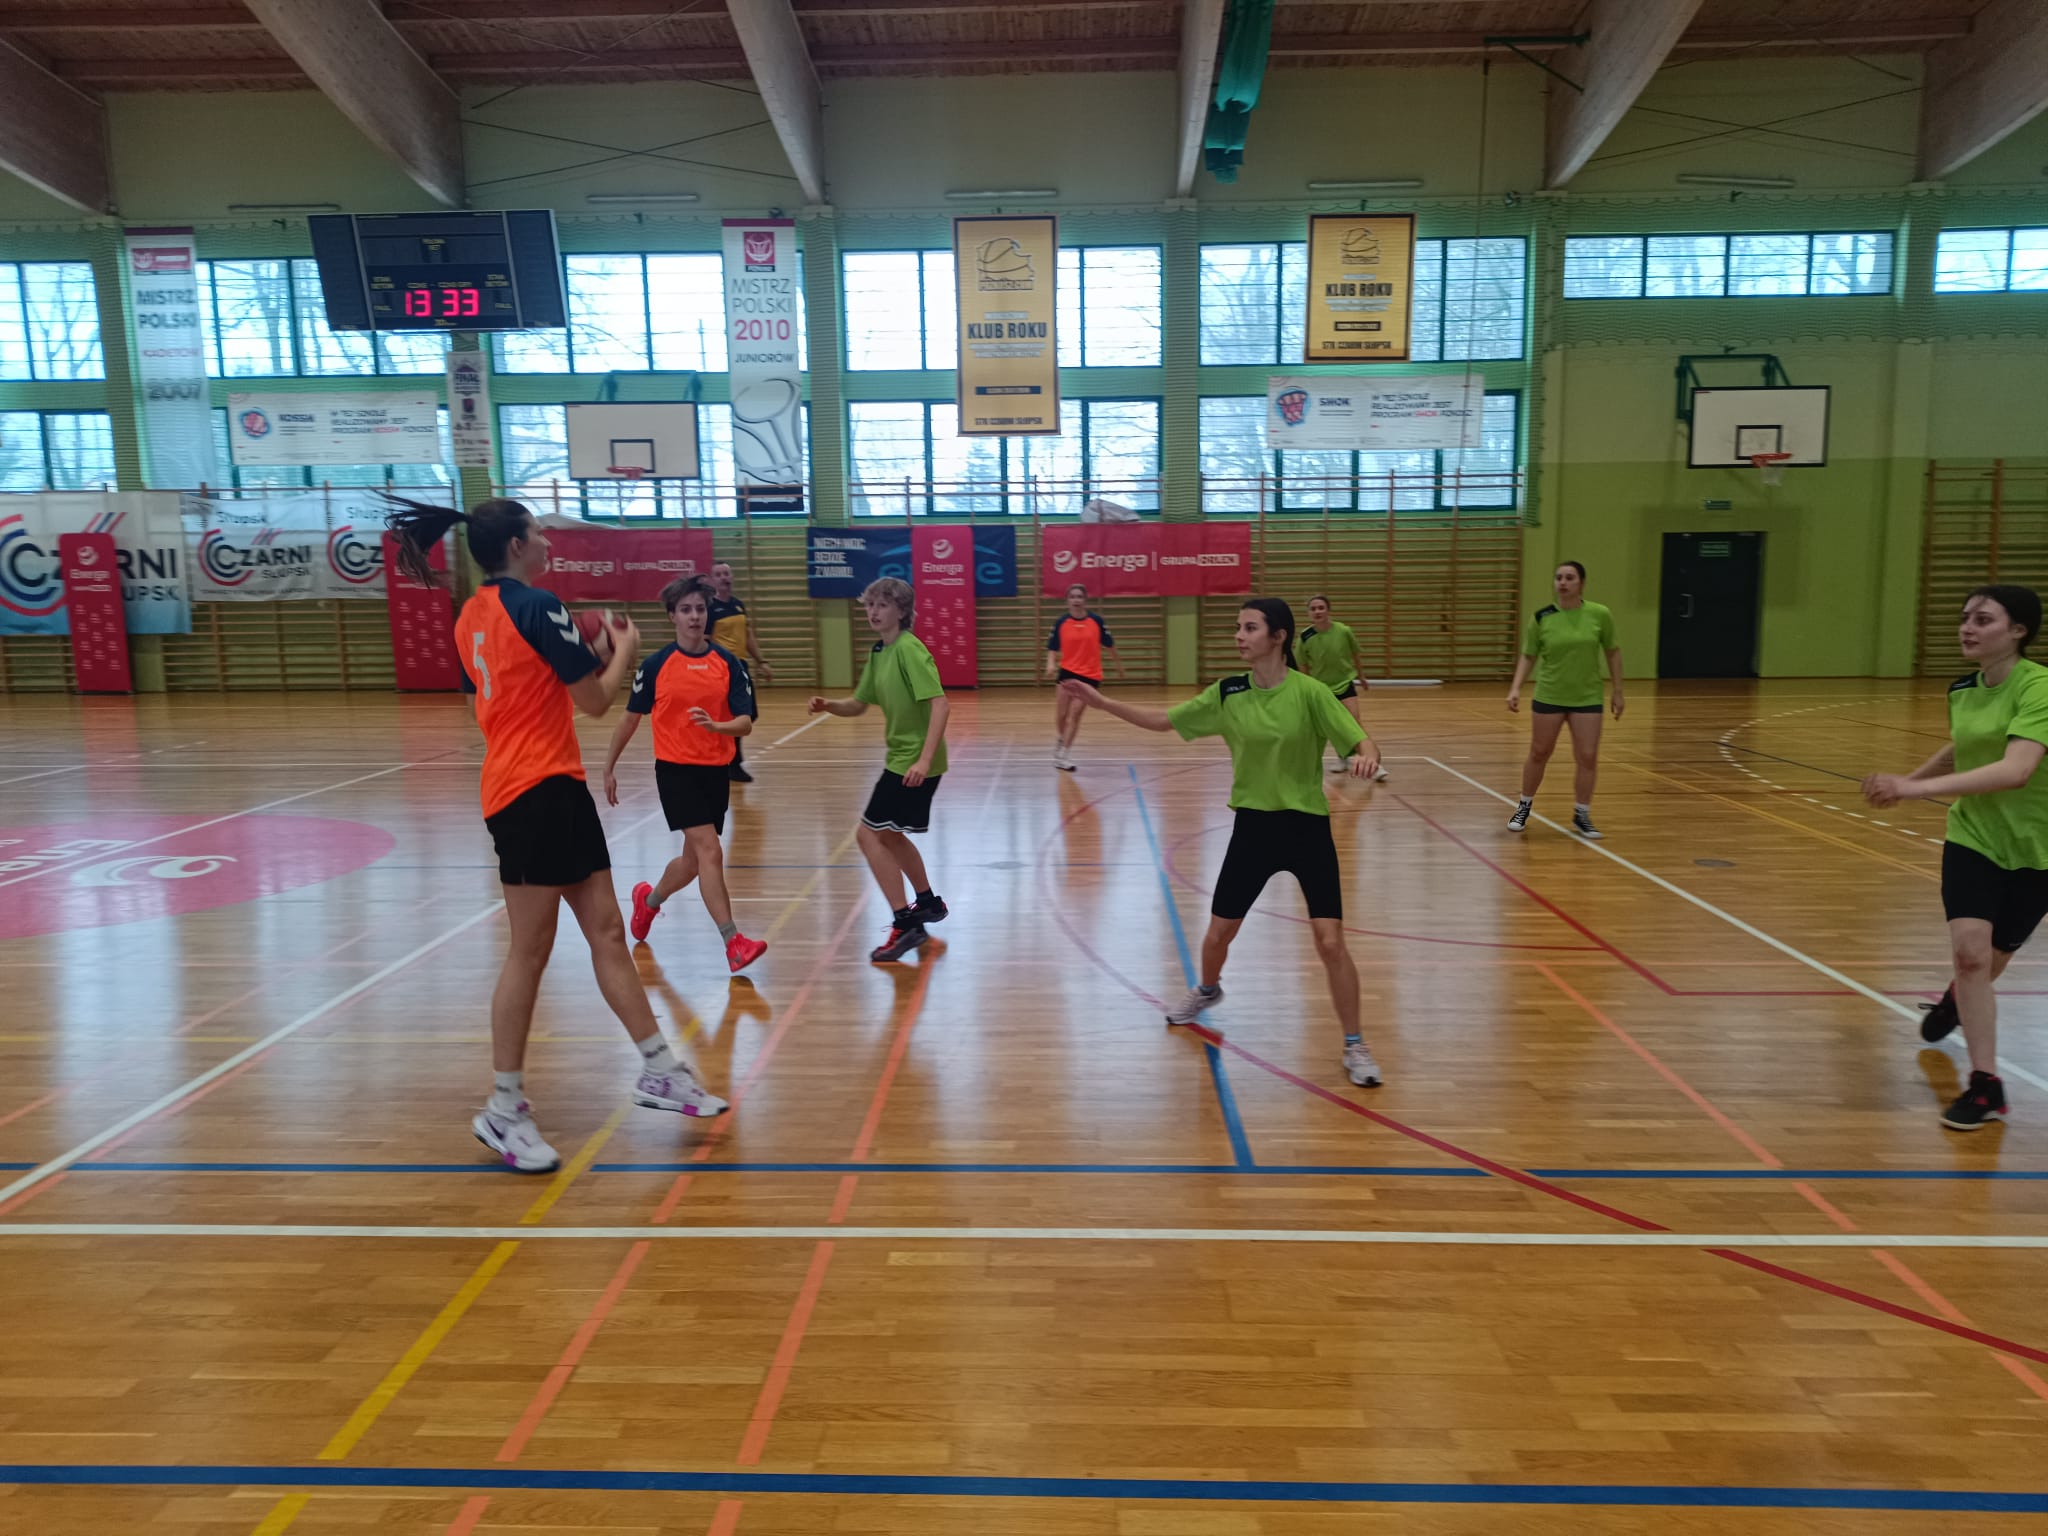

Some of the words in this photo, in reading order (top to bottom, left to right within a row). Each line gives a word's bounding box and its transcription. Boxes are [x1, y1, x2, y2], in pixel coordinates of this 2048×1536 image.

[731, 279, 790, 294] MISTRZ
[1326, 283, 1356, 296] KLUB
[1359, 283, 1392, 296] ROKU
[136, 289, 196, 305] MISTRZ
[405, 289, 432, 316] 13
[442, 289, 480, 316] 33
[733, 298, 792, 313] POLSKI
[138, 313, 197, 328] POLSKI
[734, 320, 790, 340] 2010
[968, 324, 1003, 338] KLUB
[1008, 322, 1047, 338] ROKU
[735, 353, 794, 363] JUNIORÓW
[9, 543, 178, 587] CRNI
[214, 544, 312, 570] CZARNI
[1081, 552, 1148, 571] Energa
[552, 558, 614, 576] Energa
[922, 562, 964, 575] Energa
[121, 585, 181, 601] UPSK
[472, 632, 491, 699] 5
